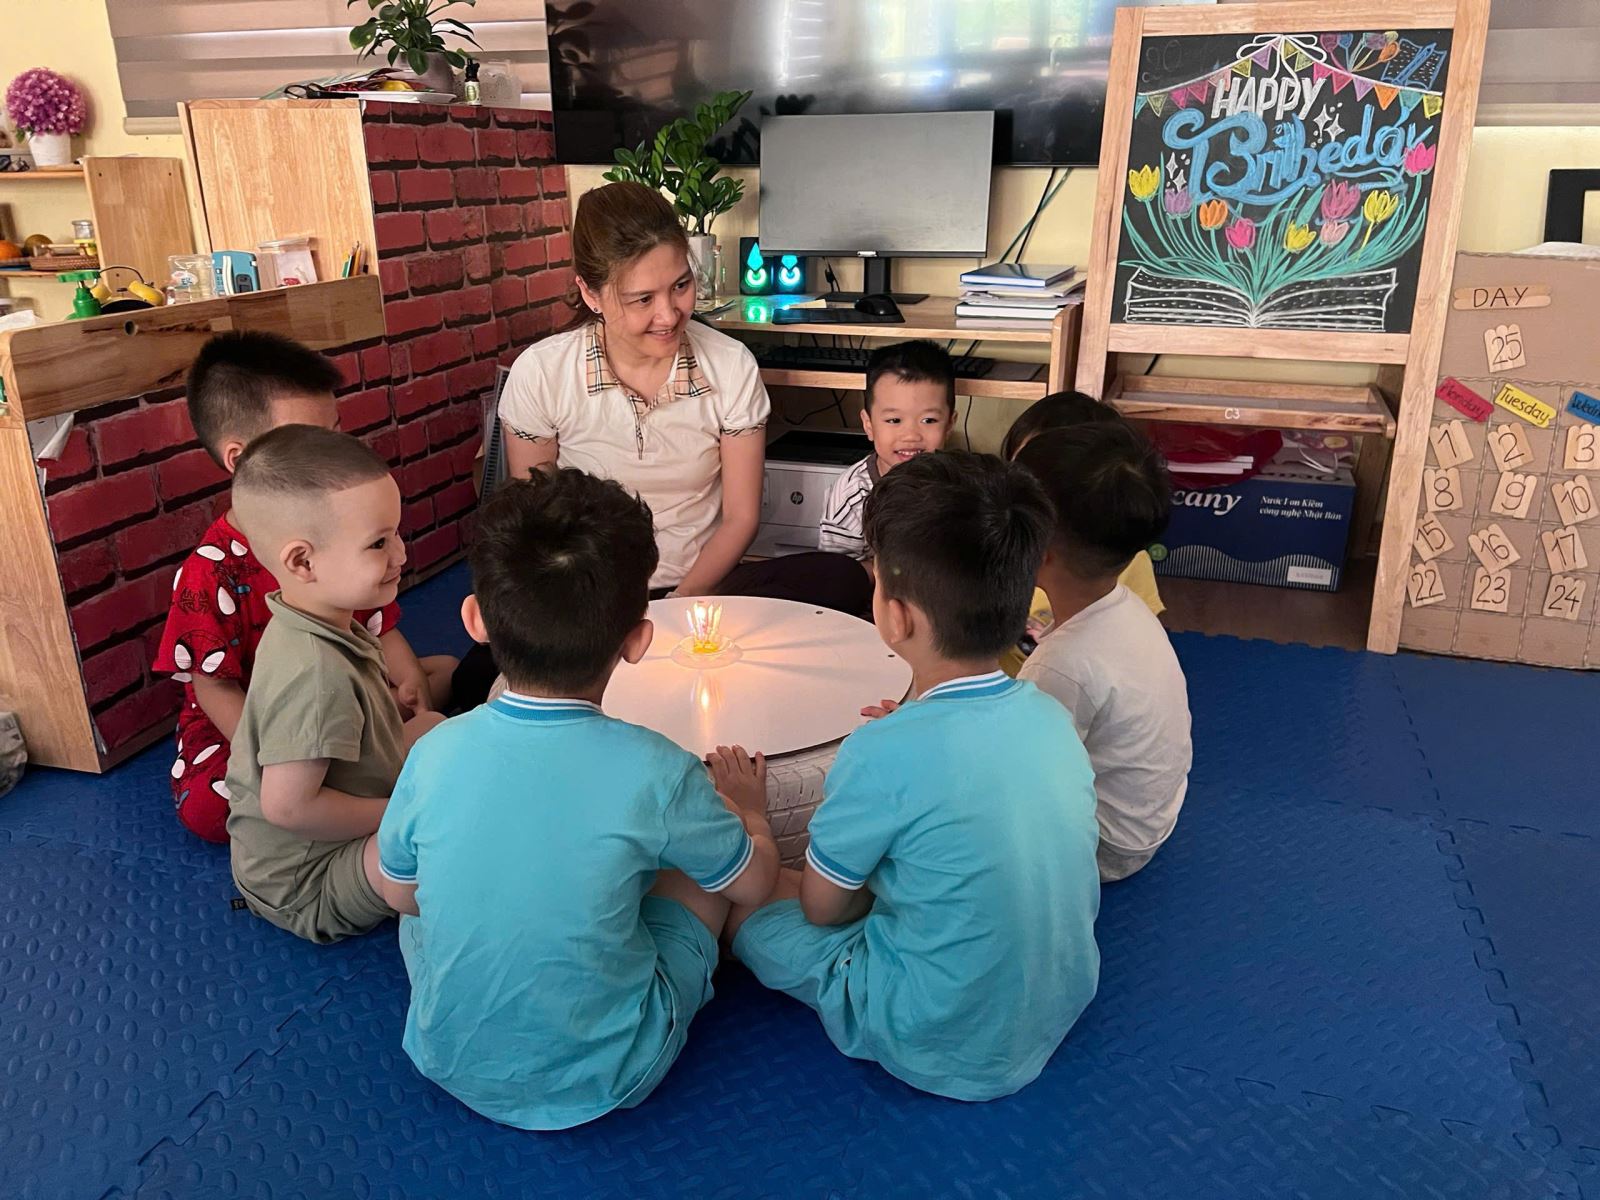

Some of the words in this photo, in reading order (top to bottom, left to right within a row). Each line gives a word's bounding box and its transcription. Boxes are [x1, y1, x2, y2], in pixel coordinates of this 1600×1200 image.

[1211, 76, 1327, 120] HAPPY
[1473, 286, 1529, 308] DAY
[1490, 331, 1524, 366] 25
[1225, 407, 1241, 420] C3
[1500, 386, 1550, 425] Tuesday
[1438, 429, 1458, 459] 1
[1498, 432, 1526, 463] 2
[1573, 433, 1595, 463] 3
[1433, 476, 1454, 508] 8
[1501, 481, 1527, 511] 9
[1561, 484, 1591, 516] 10
[1415, 520, 1447, 551] 15
[1480, 533, 1510, 562] 16
[1552, 534, 1579, 566] 17
[1411, 568, 1444, 602] 22
[1476, 574, 1507, 604] 23
[1548, 584, 1581, 613] 24
